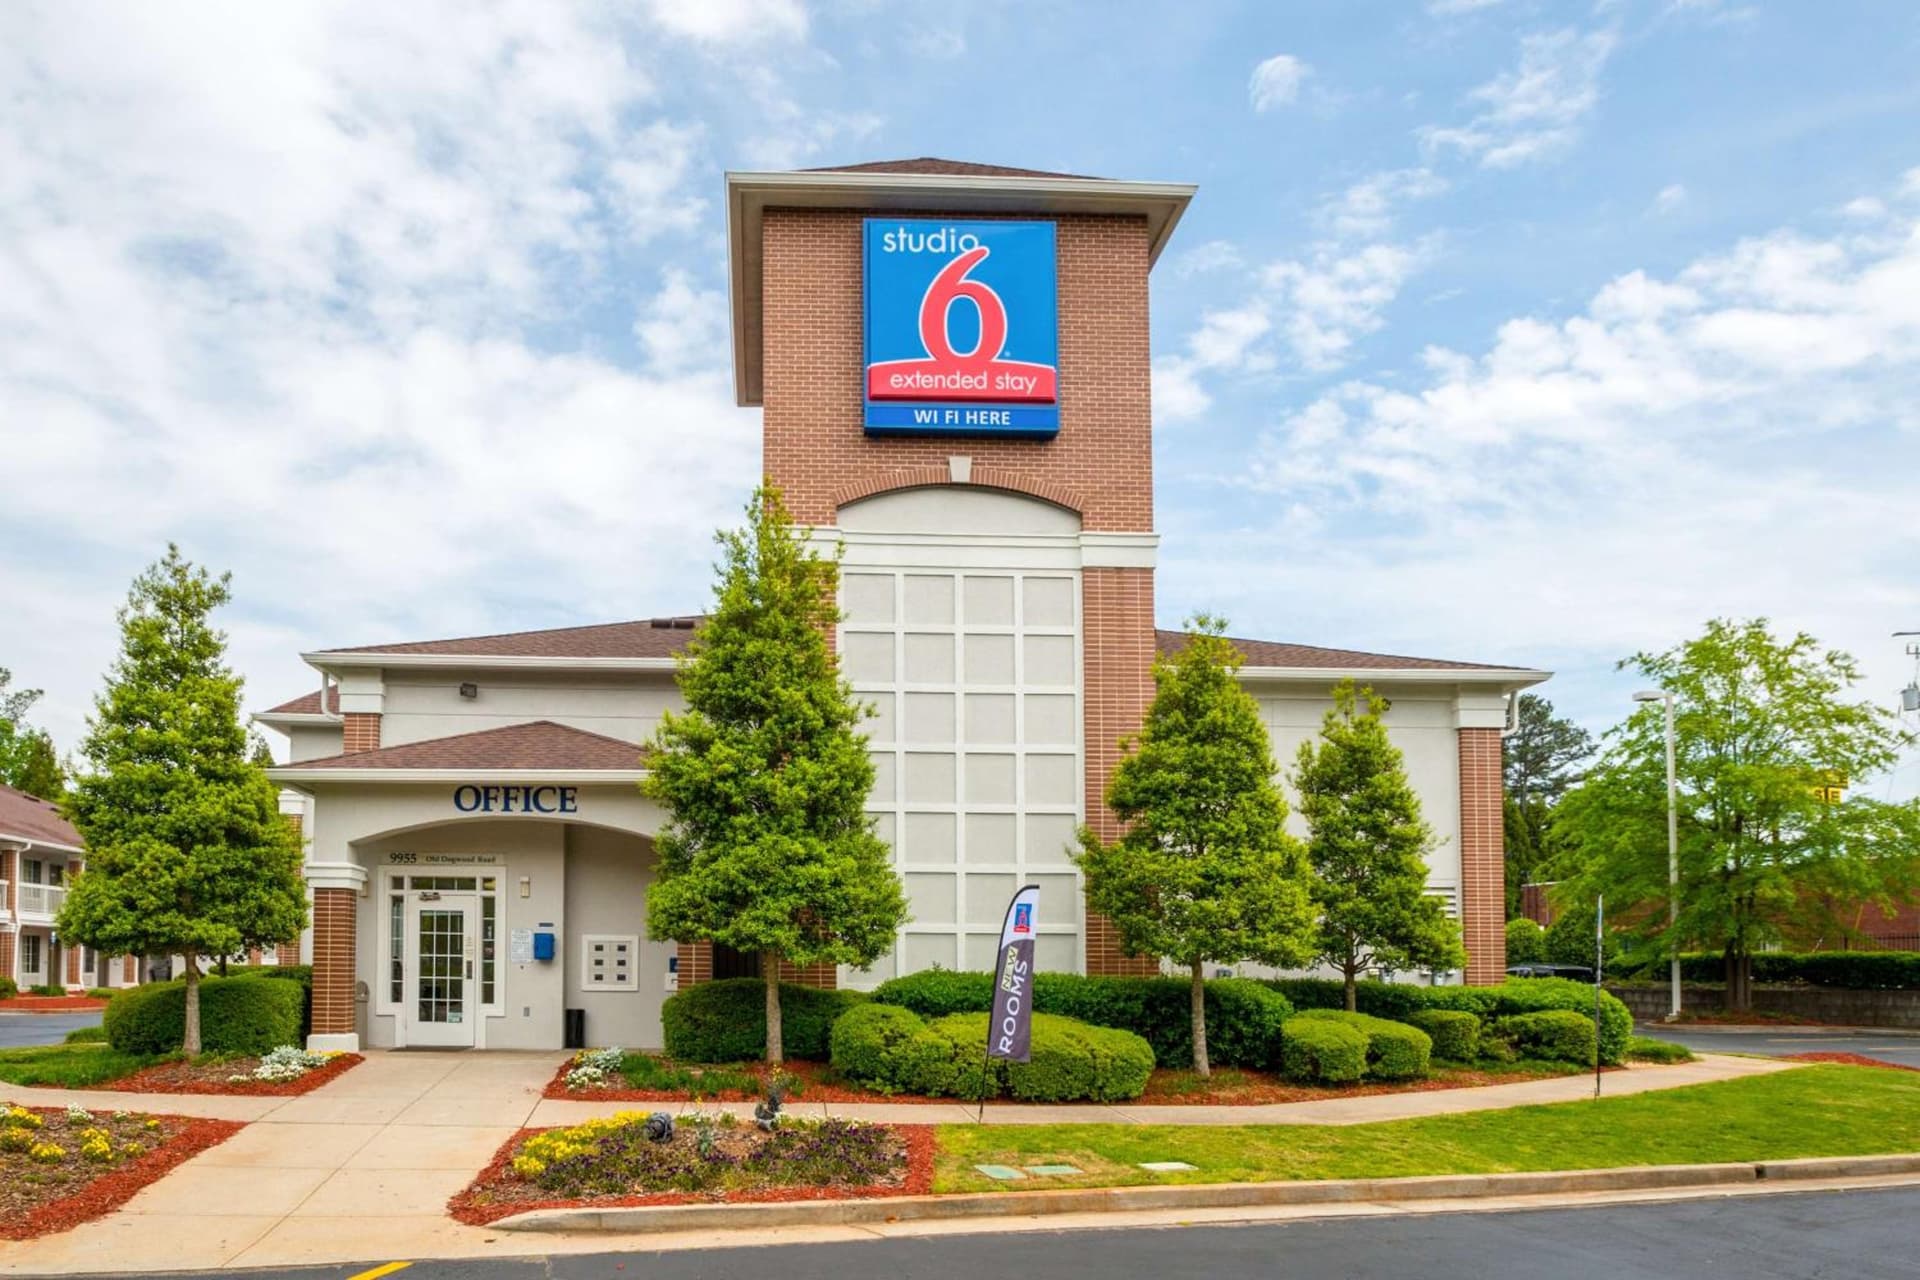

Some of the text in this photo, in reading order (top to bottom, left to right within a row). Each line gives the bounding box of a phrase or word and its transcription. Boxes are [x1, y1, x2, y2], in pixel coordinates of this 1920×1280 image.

[883, 227, 979, 253] studio
[919, 246, 1008, 360] 6
[890, 371, 1037, 394] extended stay
[914, 410, 1011, 425] WI FI HERE
[454, 785, 577, 812] OFFICE
[390, 853, 417, 863] 9955
[999, 959, 1028, 1054] ROOMS
